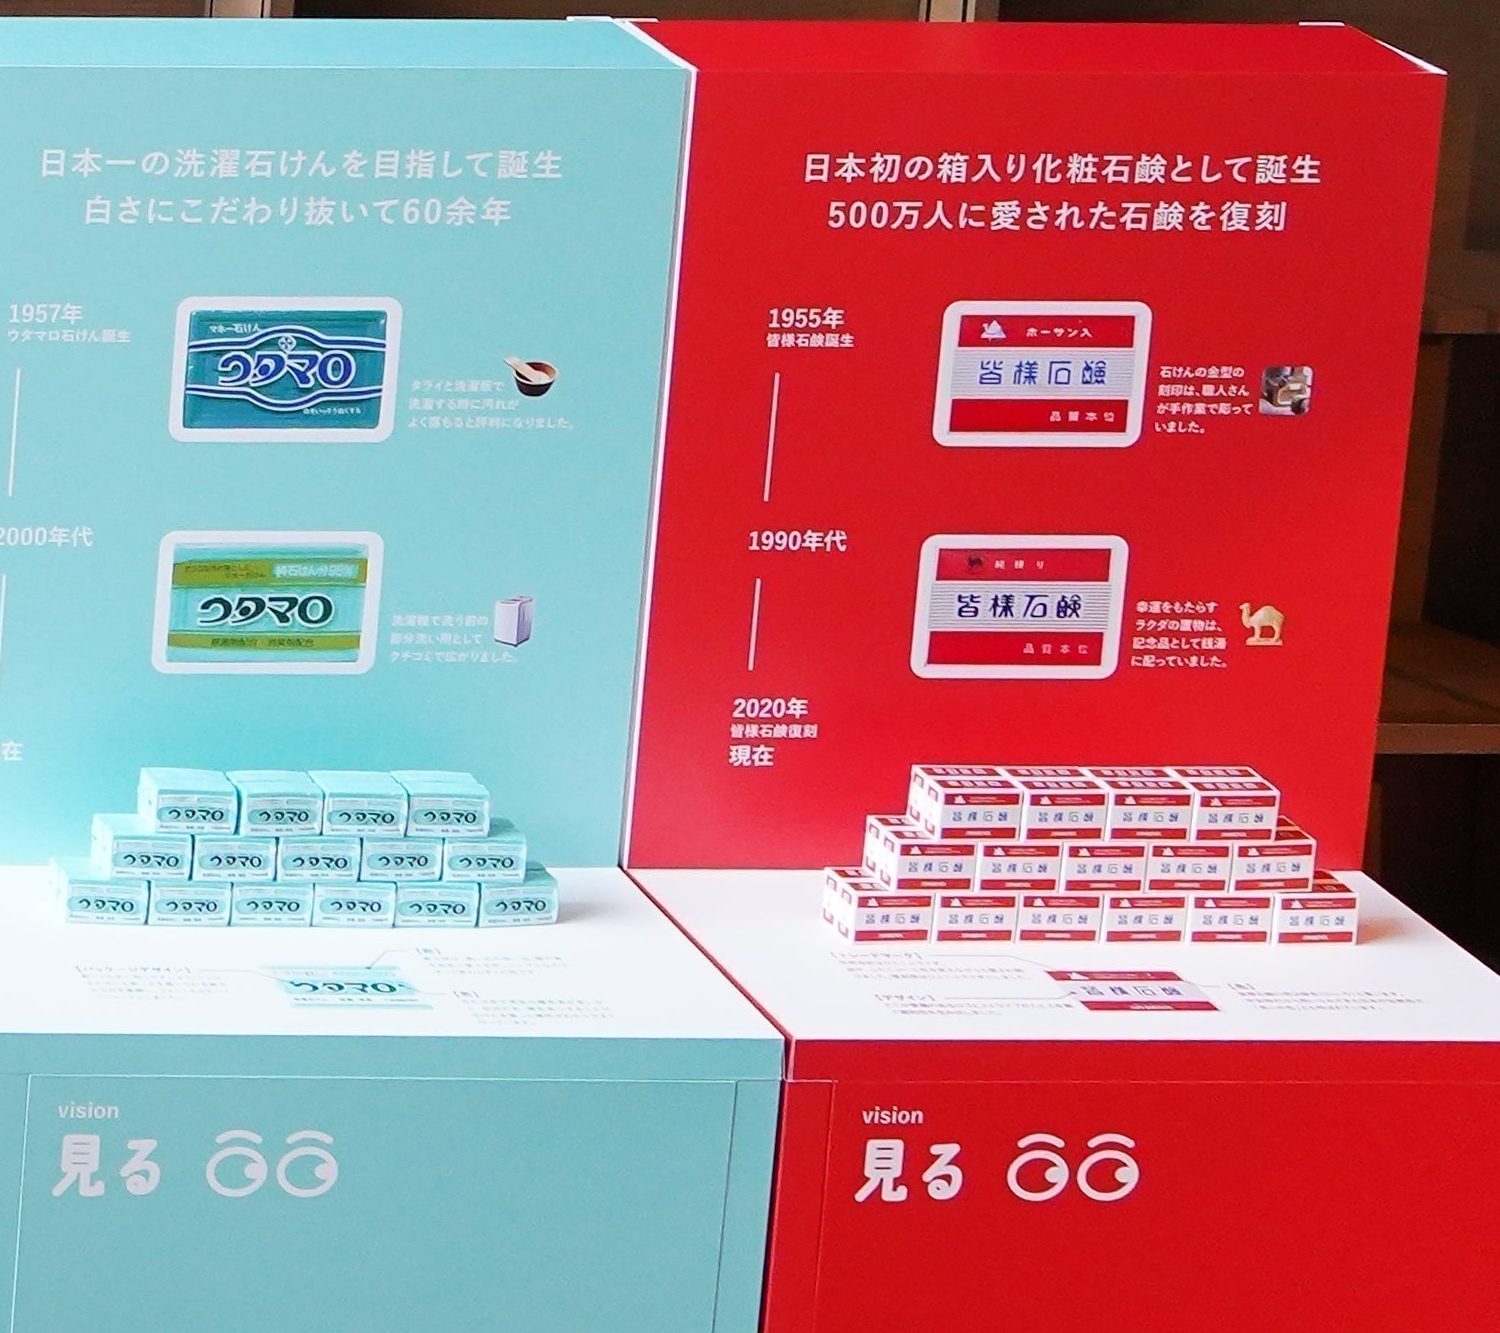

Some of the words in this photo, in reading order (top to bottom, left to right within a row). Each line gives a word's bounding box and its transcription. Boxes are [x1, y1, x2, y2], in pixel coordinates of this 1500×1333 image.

[40, 149, 564, 181] 日本一の洗濯石けんを目指して誕生
[803, 152, 1322, 185] 日本初の箱入り化粧石鹸として誕生
[84, 193, 512, 228] 白さにこだわり抜いて60余年
[828, 199, 1287, 233] 500万人に愛された石鹸を復刻
[8, 302, 83, 326] 1957年
[767, 306, 845, 331] 1955年
[978, 360, 1108, 387] 皆様石鹸
[747, 529, 848, 553] 1990年代
[957, 592, 1083, 620] 皆様石鹸
[732, 696, 809, 719] 2020年
[728, 743, 775, 768] 現在
[58, 1101, 120, 1121] vision
[861, 1106, 925, 1127] vision
[52, 1133, 161, 1199] 見る
[854, 1138, 964, 1203] 見る
